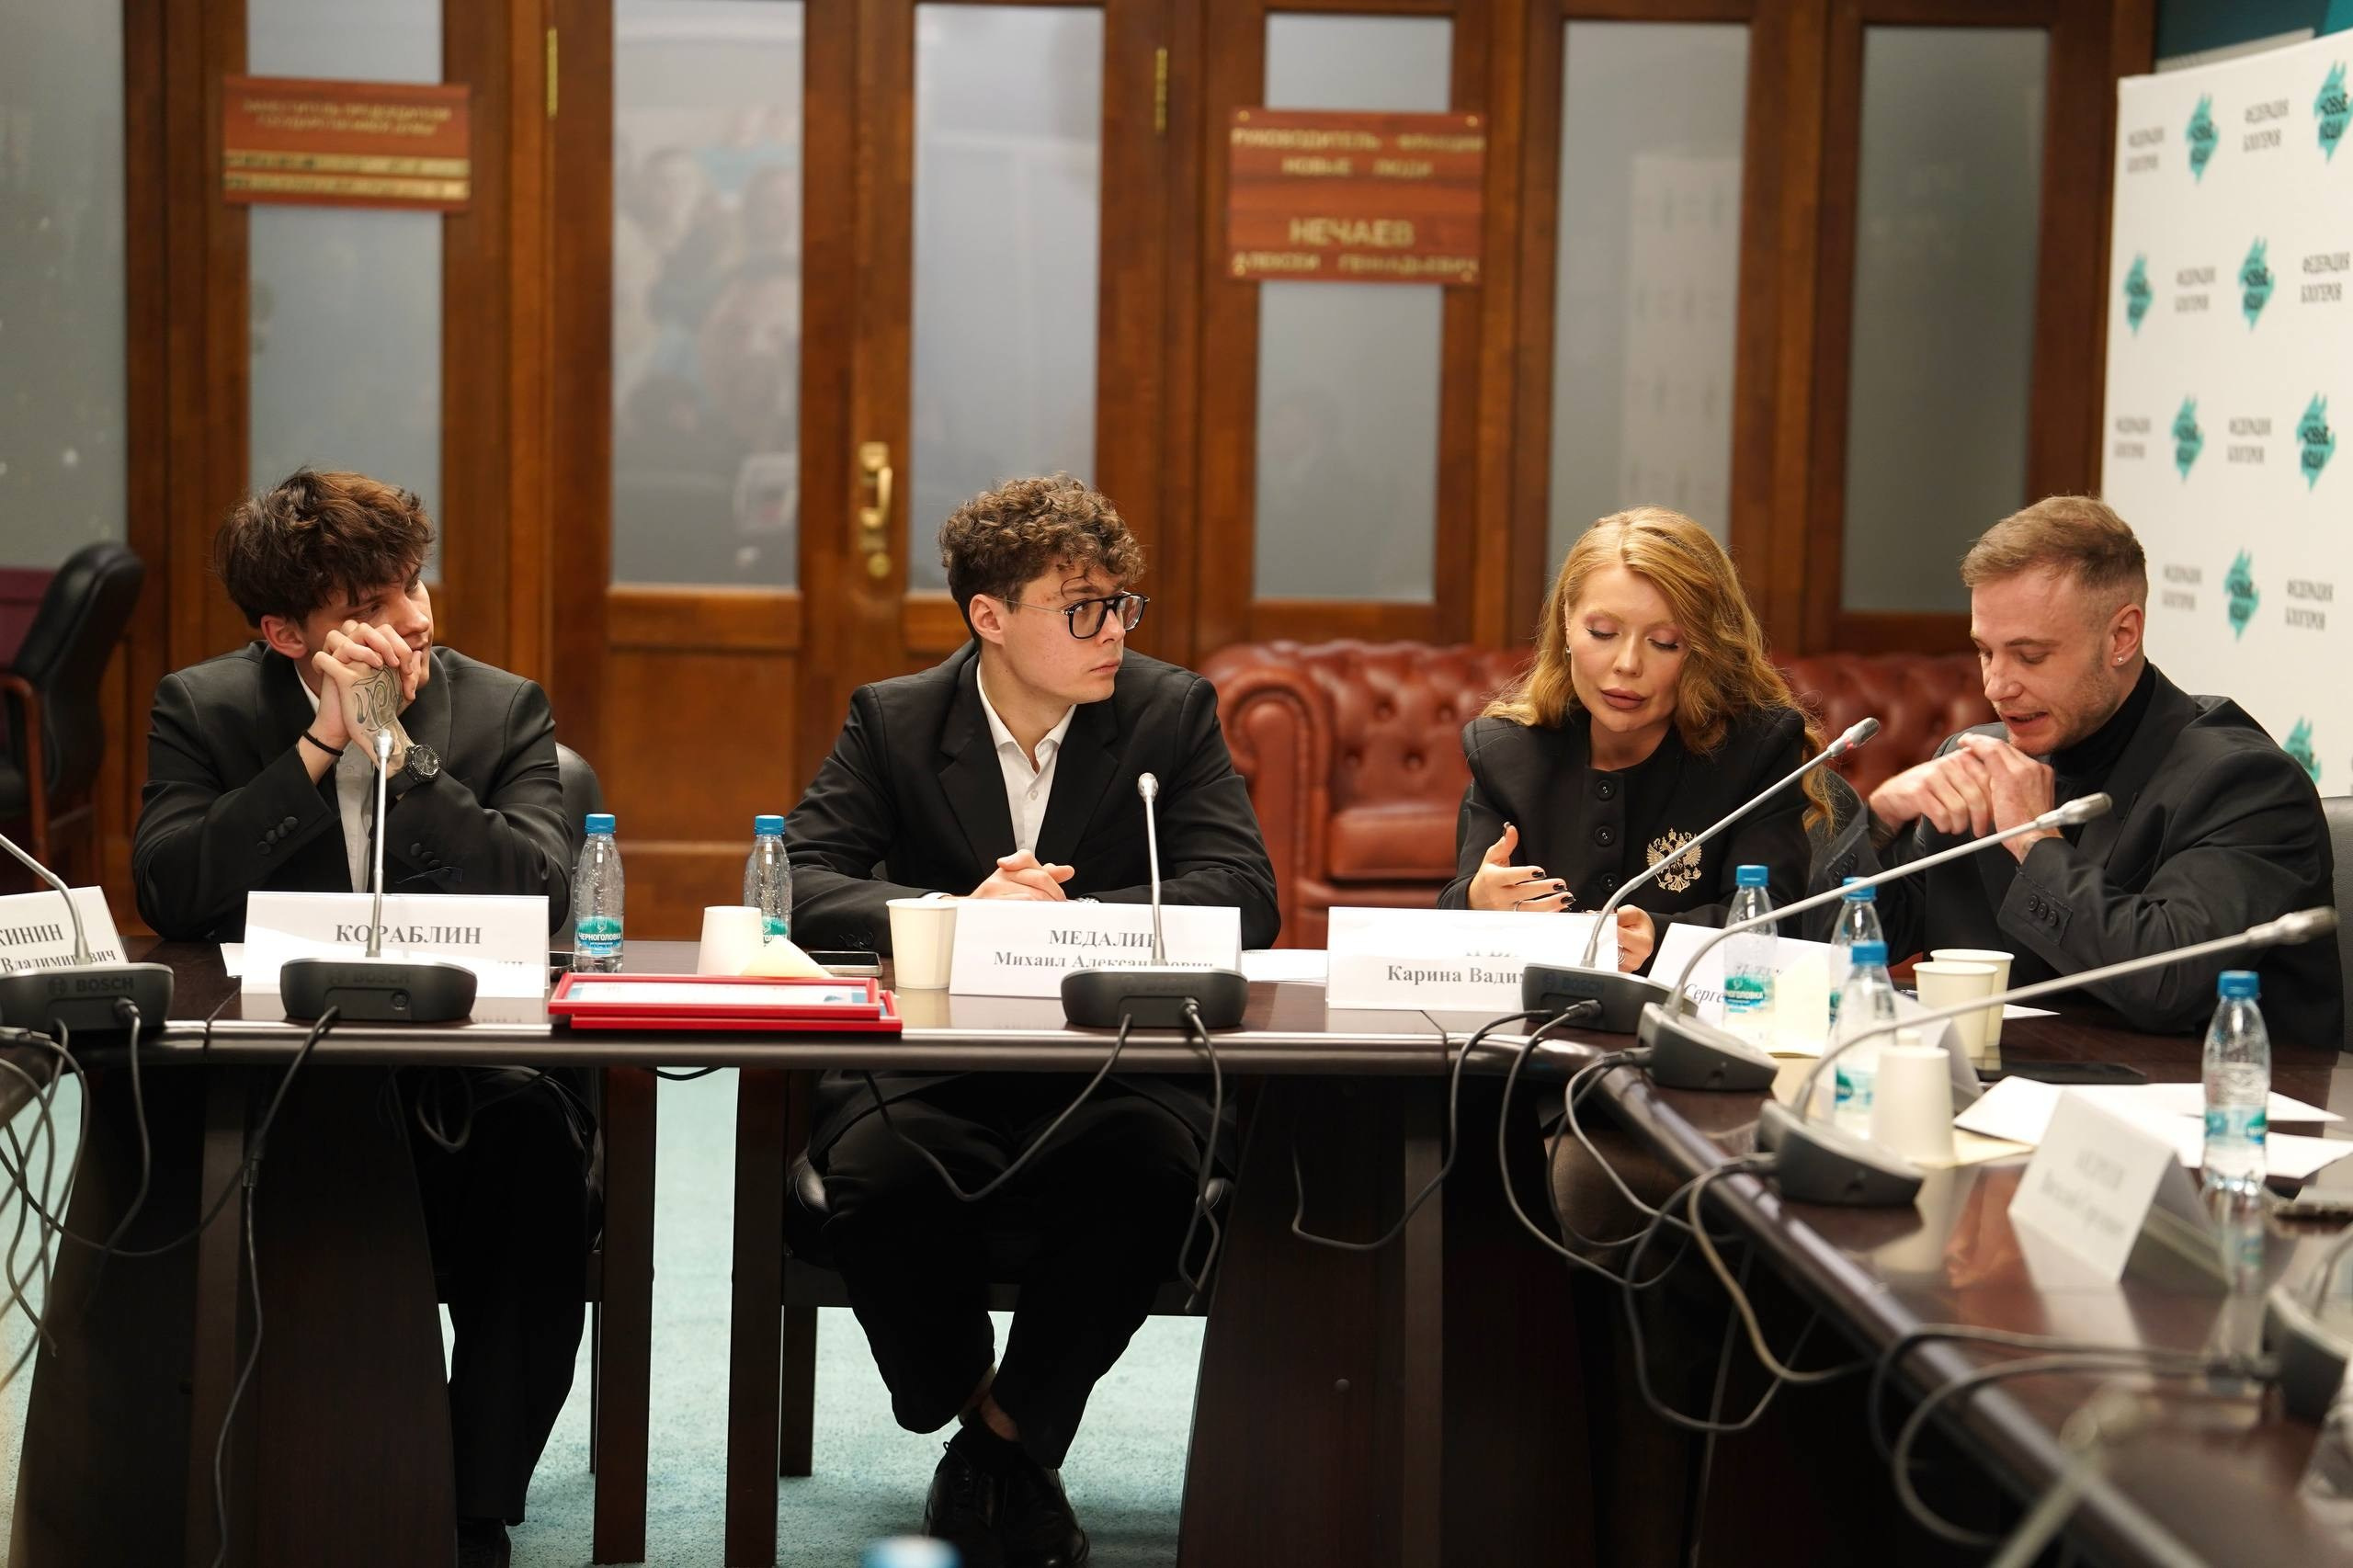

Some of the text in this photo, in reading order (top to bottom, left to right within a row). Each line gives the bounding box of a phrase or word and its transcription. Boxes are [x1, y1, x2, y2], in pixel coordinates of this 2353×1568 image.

[1290, 217, 1415, 248] НЕЧАЕВ
[335, 924, 482, 945] КОРАБЛИН
[1, 949, 116, 973] Владимивич
[995, 950, 1066, 968] Михаил
[75, 977, 134, 993] BOSCH
[1387, 965, 1523, 985] Карина Вади
[1684, 983, 1724, 1005] Серге
